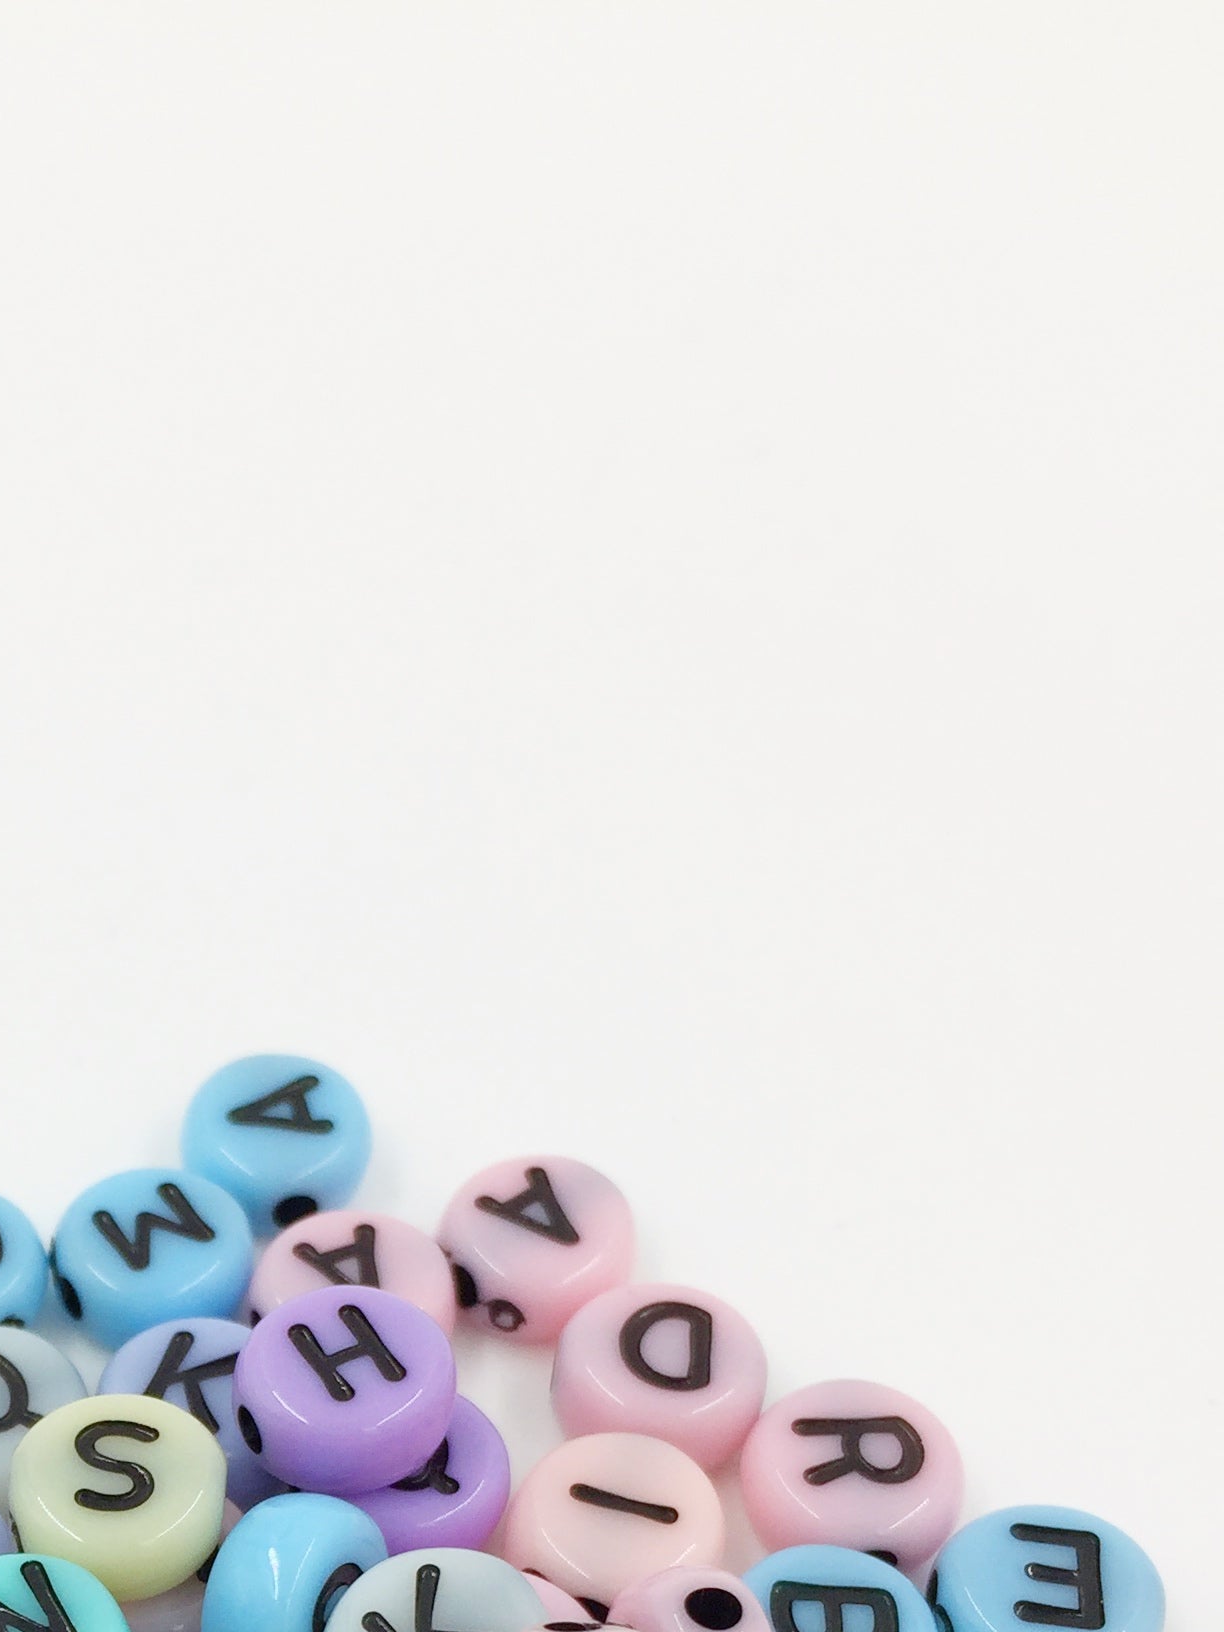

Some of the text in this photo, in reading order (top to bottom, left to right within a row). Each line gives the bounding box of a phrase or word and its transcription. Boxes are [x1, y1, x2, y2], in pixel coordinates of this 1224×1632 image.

[227, 1075, 334, 1134] A
[476, 1167, 580, 1244] A
[142, 1331, 240, 1436] K
[287, 1304, 407, 1402] H
[619, 1301, 713, 1392] D
[73, 1419, 160, 1512] S
[793, 1416, 925, 1486] R
[1010, 1523, 1106, 1631] E
